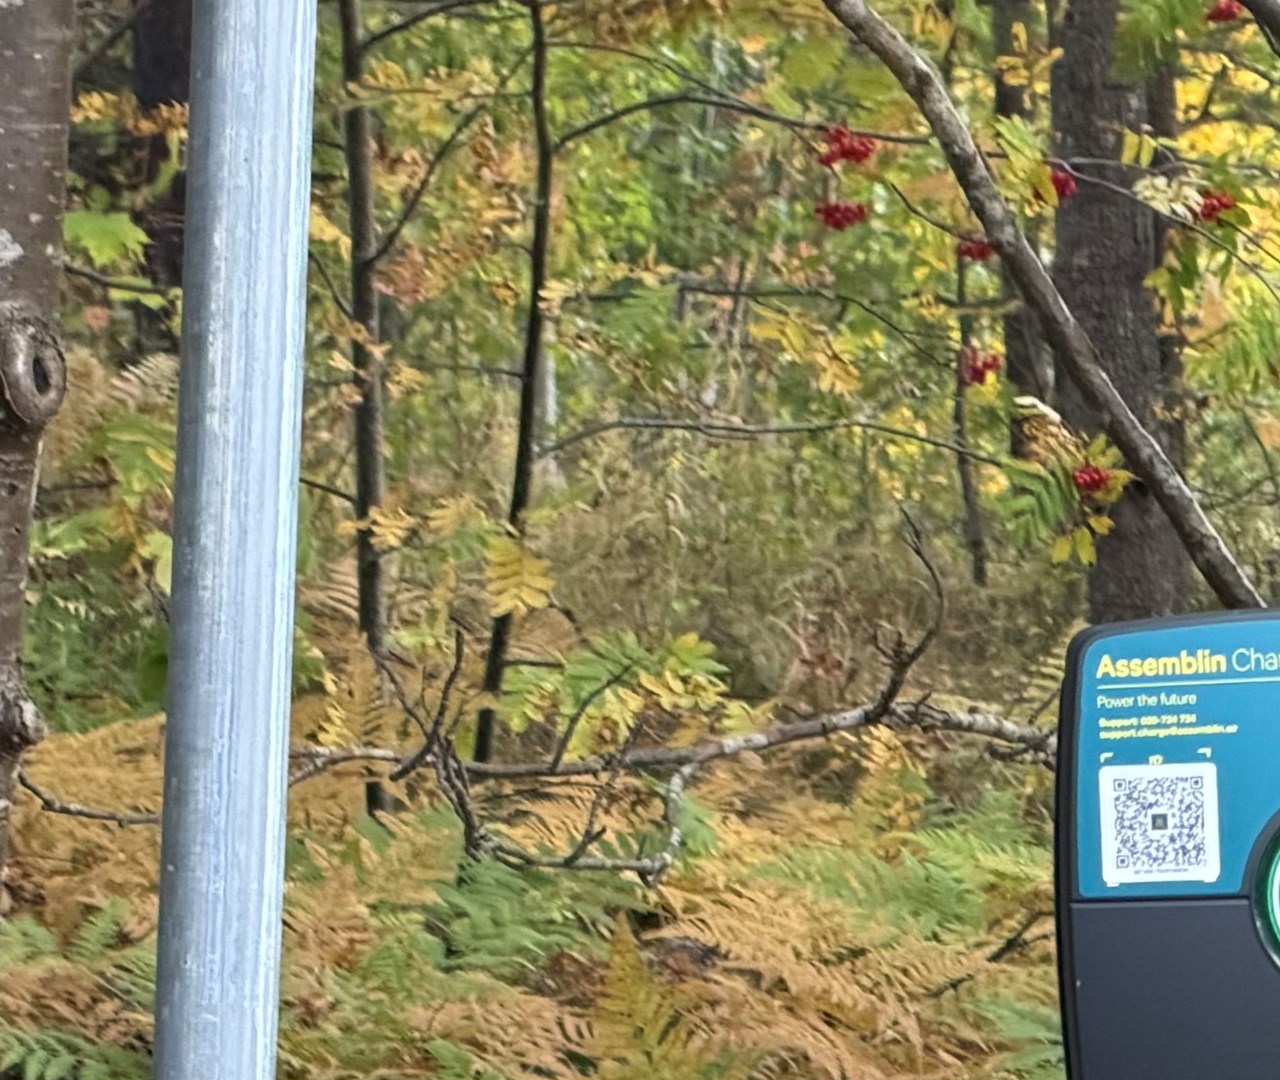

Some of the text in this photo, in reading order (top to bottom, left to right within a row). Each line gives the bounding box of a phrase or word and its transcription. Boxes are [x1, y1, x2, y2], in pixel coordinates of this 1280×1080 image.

[1095, 649, 1227, 679] Assemblin
[1097, 692, 1197, 709] Power the future
